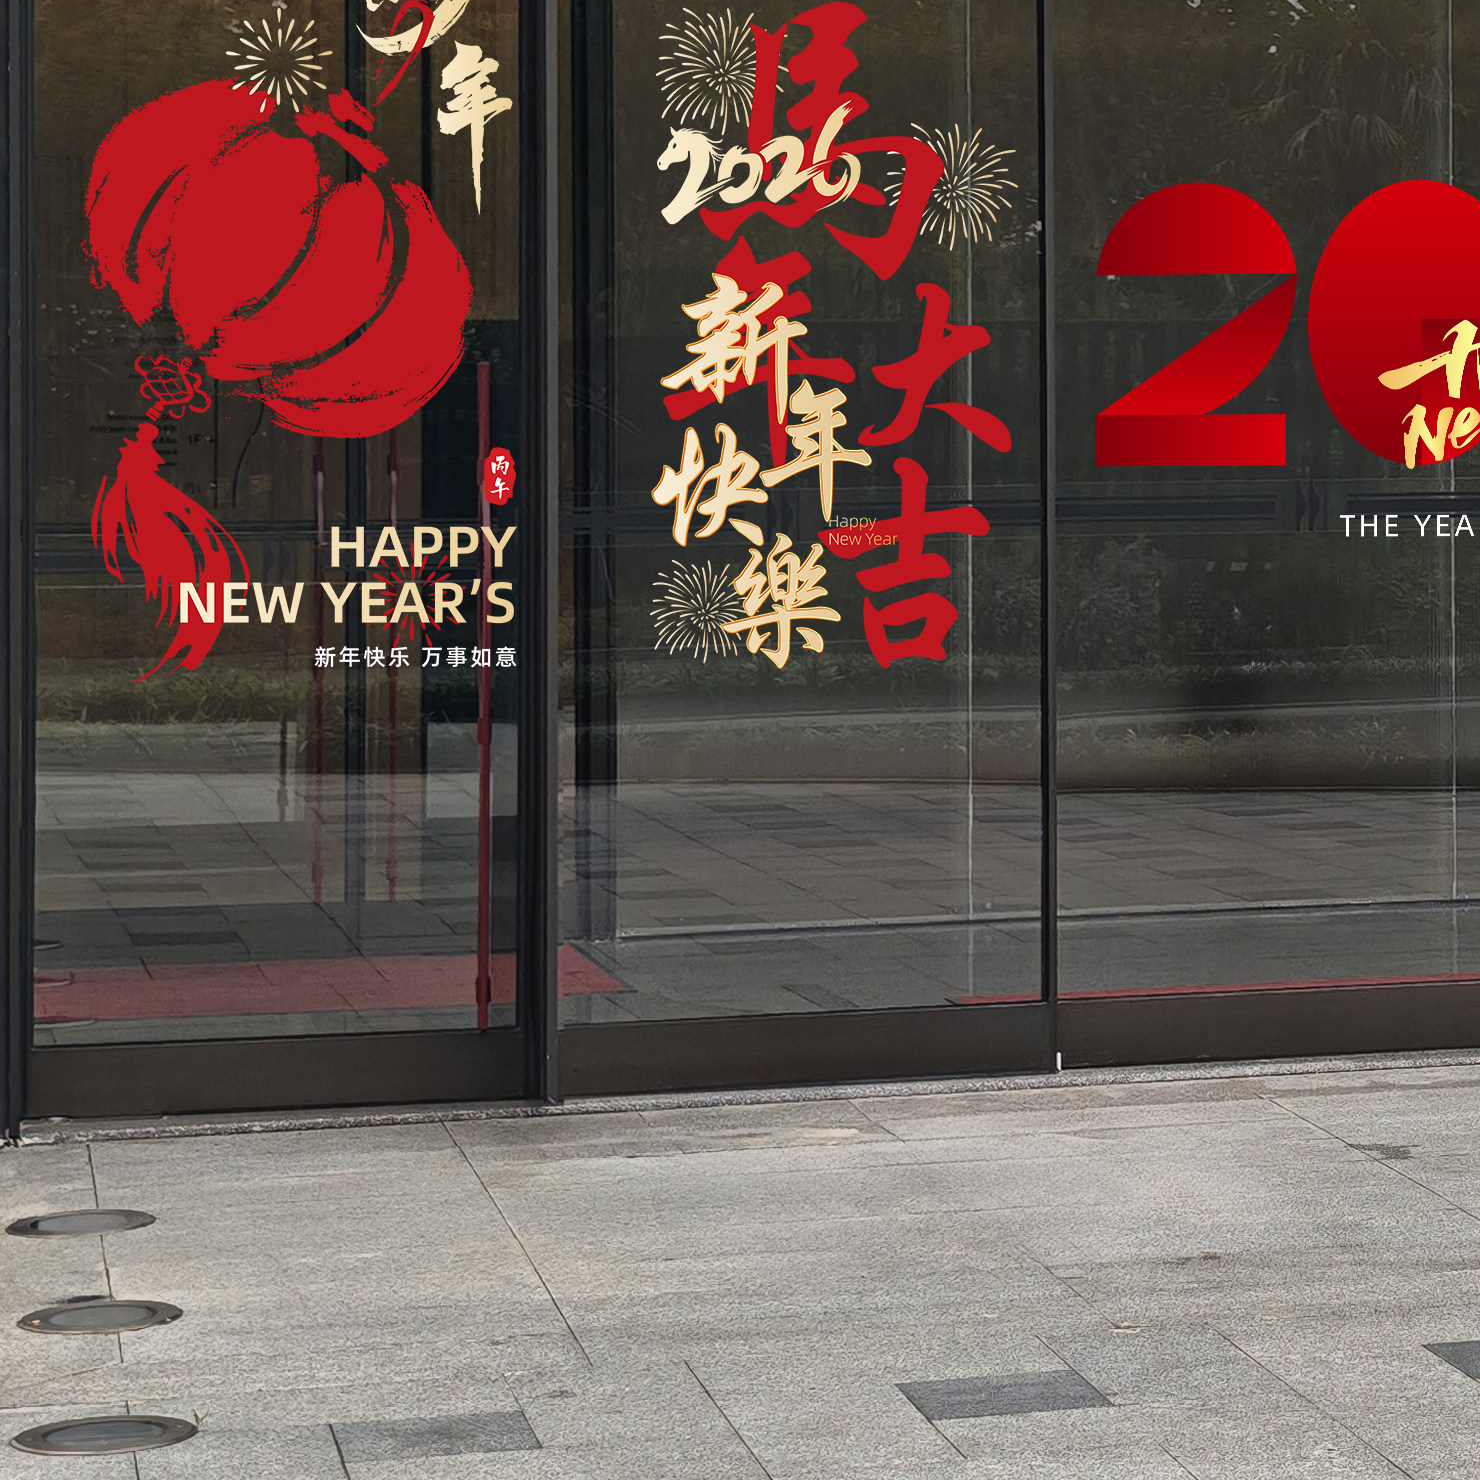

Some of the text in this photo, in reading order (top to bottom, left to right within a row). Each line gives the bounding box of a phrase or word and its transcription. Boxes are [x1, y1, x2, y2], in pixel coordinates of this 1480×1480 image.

[656, 100, 861, 225] 2026
[828, 515, 877, 531] Happy
[1339, 514, 1399, 537] THE
[330, 526, 517, 568] HAPPY
[828, 532, 898, 546] New Year
[179, 578, 515, 624] NEW YEAR'S
[314, 646, 517, 668] 新年快乐 万事如意
